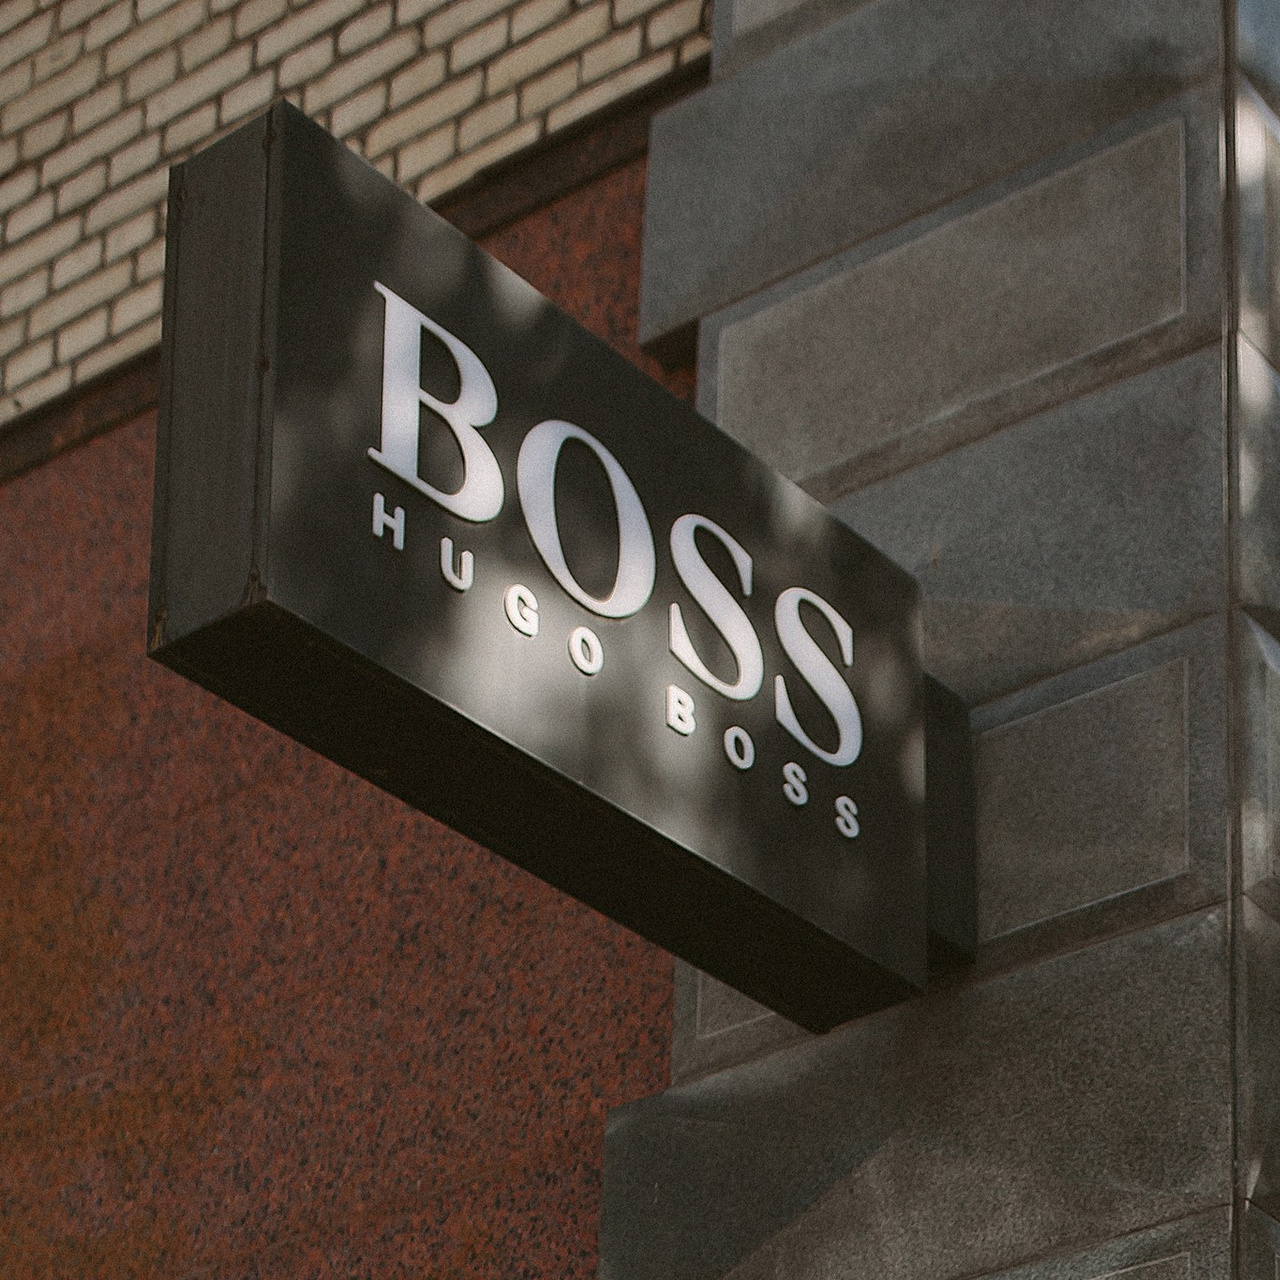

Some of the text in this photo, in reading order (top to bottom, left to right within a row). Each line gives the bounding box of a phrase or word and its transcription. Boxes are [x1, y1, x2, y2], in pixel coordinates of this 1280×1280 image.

[367, 280, 862, 768] BOSS
[372, 492, 861, 838] HUGO BOSS
